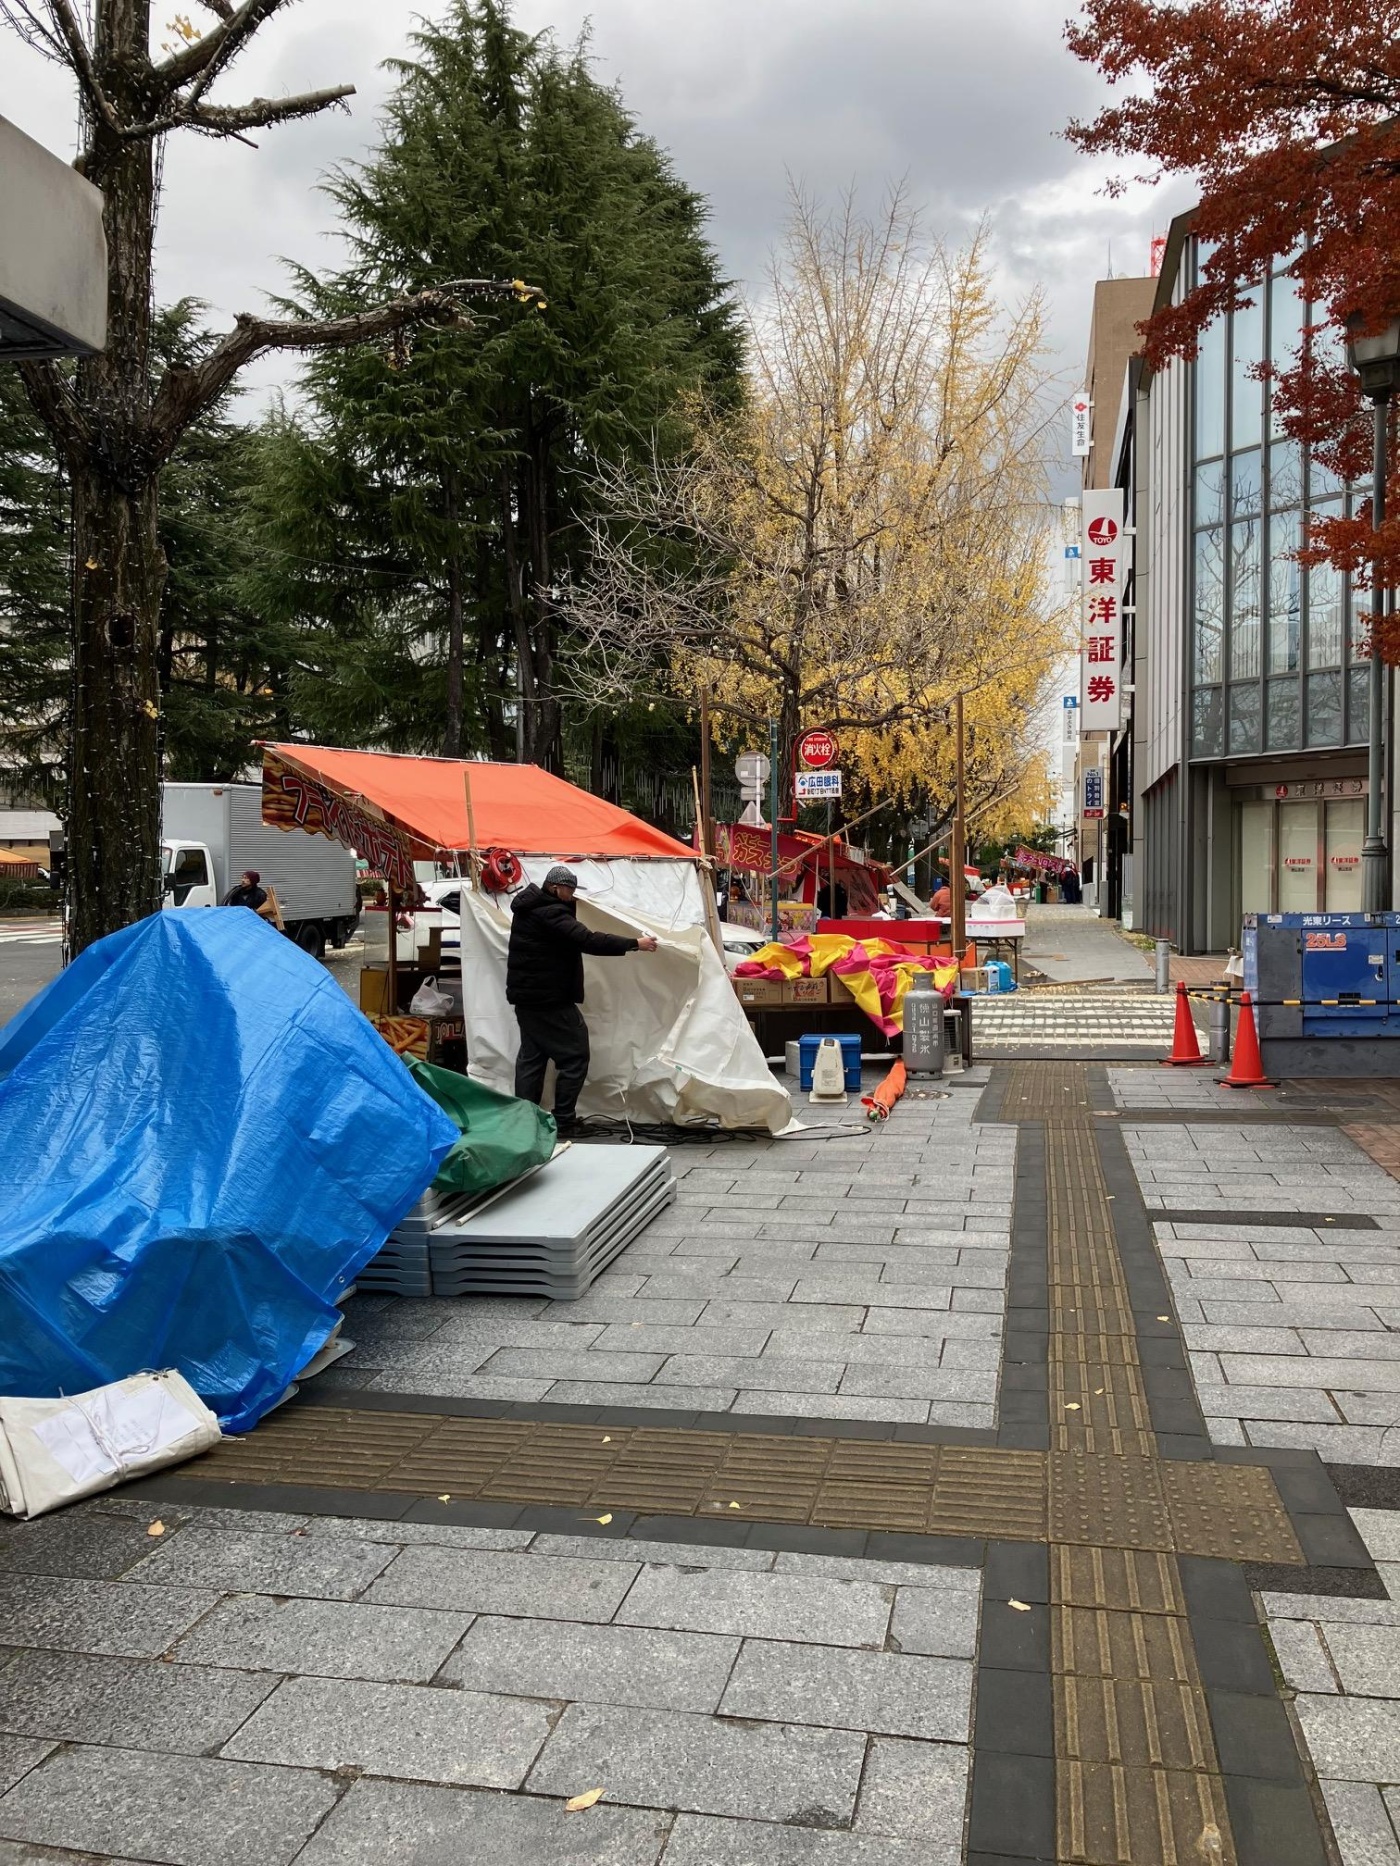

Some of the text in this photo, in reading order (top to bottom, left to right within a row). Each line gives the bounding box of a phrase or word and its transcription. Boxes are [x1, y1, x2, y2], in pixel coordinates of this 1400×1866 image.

[1076, 413, 1086, 447] 住友生命
[1092, 536, 1113, 545] TOYO
[1087, 556, 1117, 704] 東洋証券
[804, 743, 831, 756] 消火栓
[808, 775, 839, 787] 広田眼科
[734, 832, 771, 848] ベビー
[732, 844, 798, 875] カステラ
[1302, 915, 1351, 925] 光東リース
